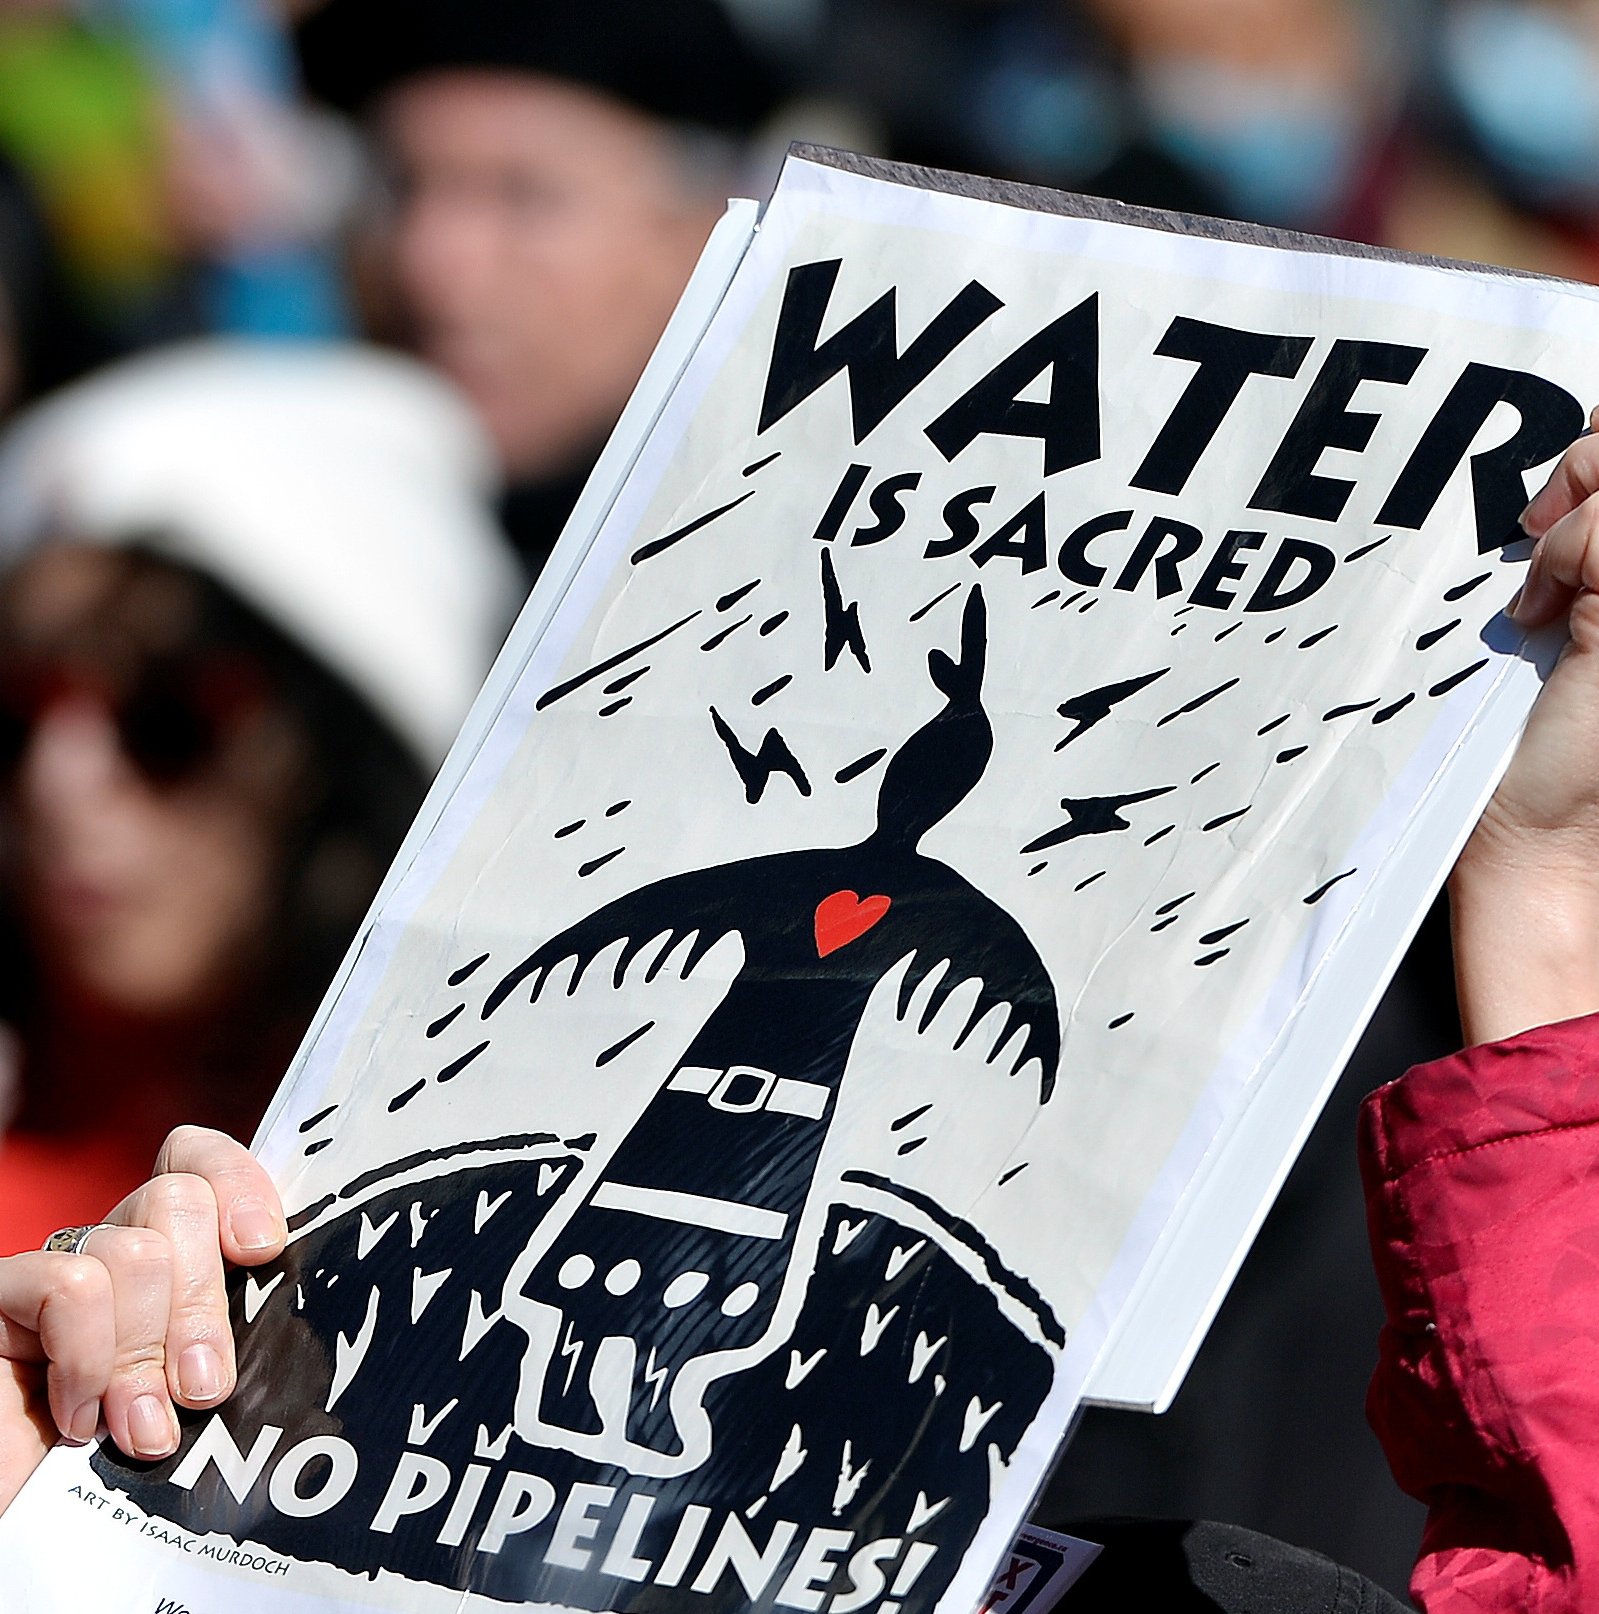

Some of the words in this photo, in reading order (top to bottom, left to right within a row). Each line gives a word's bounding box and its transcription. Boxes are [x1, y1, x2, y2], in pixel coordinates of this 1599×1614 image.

[757, 257, 1586, 557] WATER
[812, 463, 921, 548] IS
[923, 484, 1338, 614] SACRED
[68, 1485, 110, 1510] ART
[112, 1508, 138, 1525] BY
[140, 1522, 198, 1553] ISAAC
[198, 1544, 290, 1576] MURDOCH
[170, 1415, 360, 1521] NO
